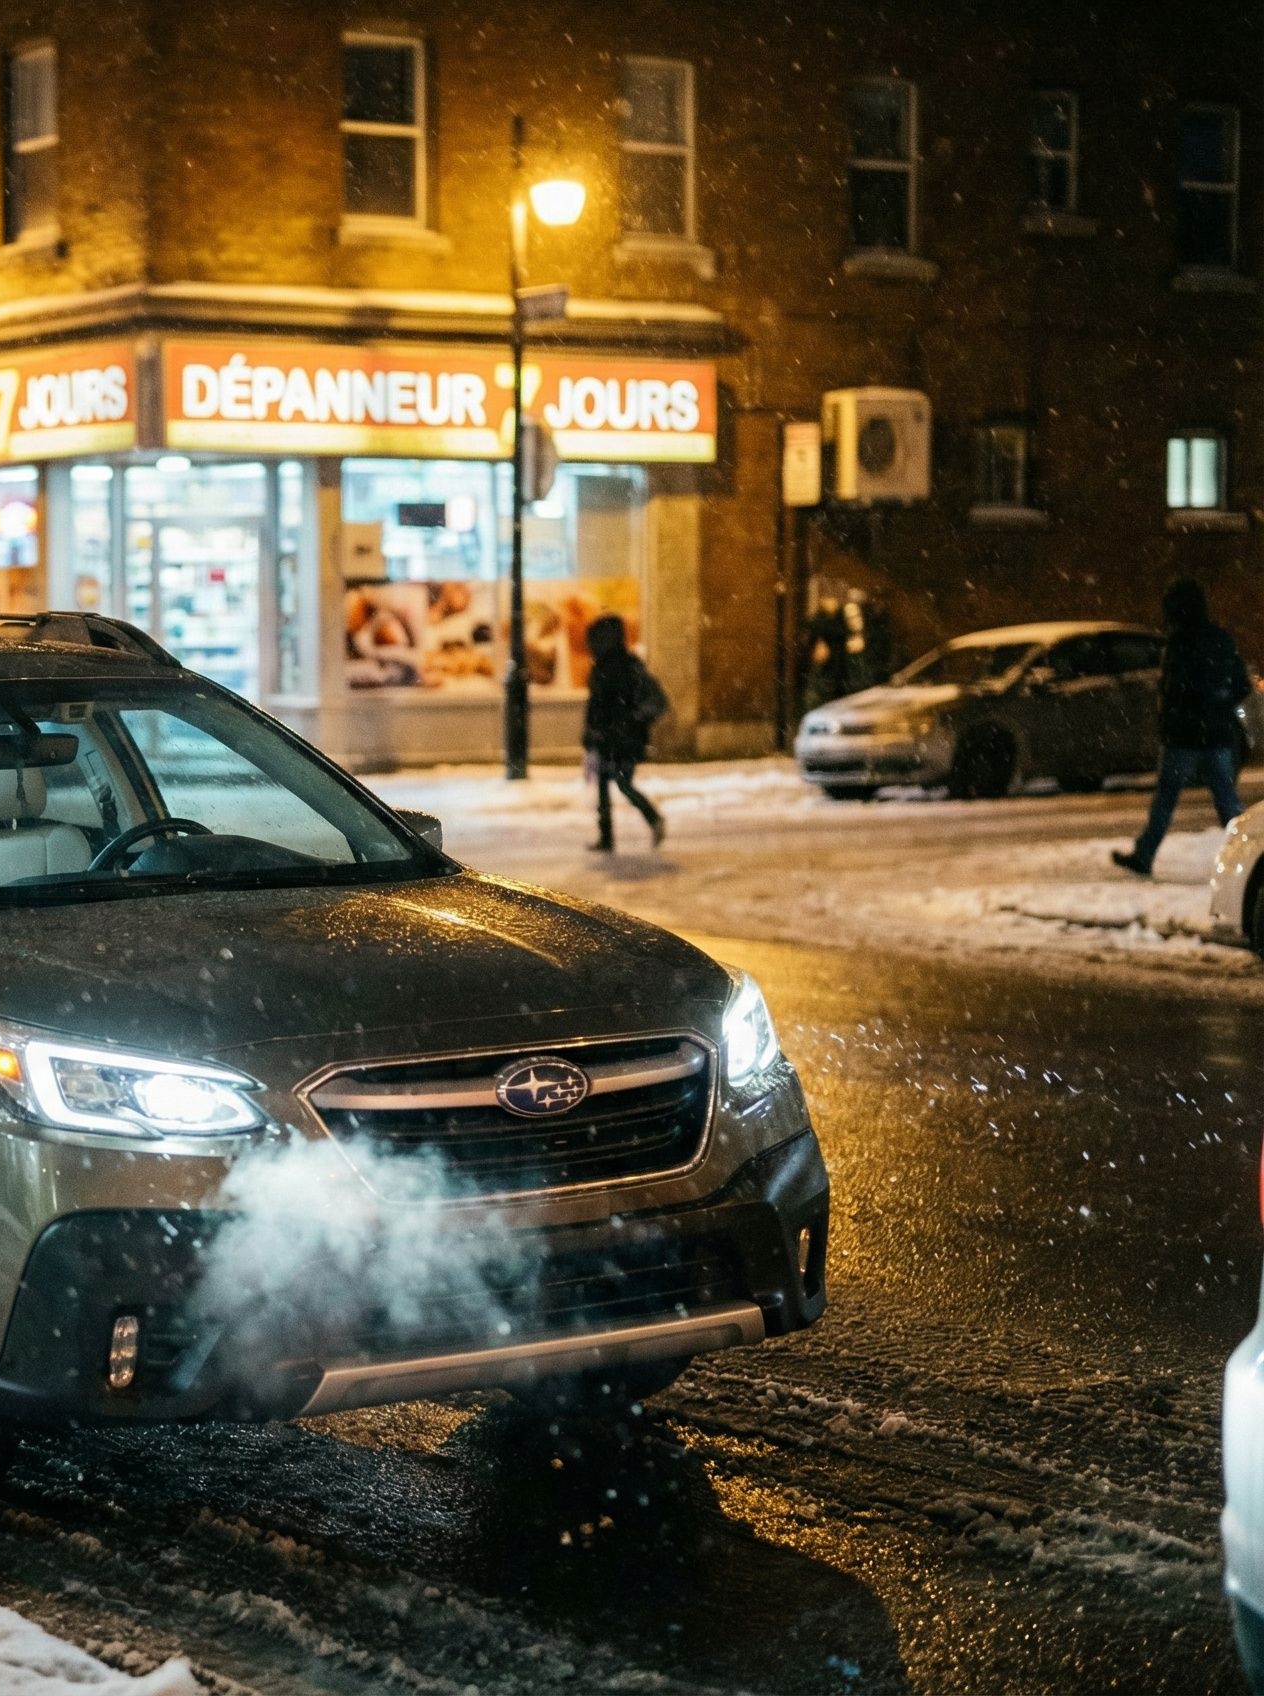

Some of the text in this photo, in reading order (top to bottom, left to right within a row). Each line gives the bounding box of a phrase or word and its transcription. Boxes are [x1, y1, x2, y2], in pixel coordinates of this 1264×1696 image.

[18, 365, 128, 429] JOURS
[181, 353, 487, 426] DÉPANNEUR
[543, 376, 700, 432] JOURS
